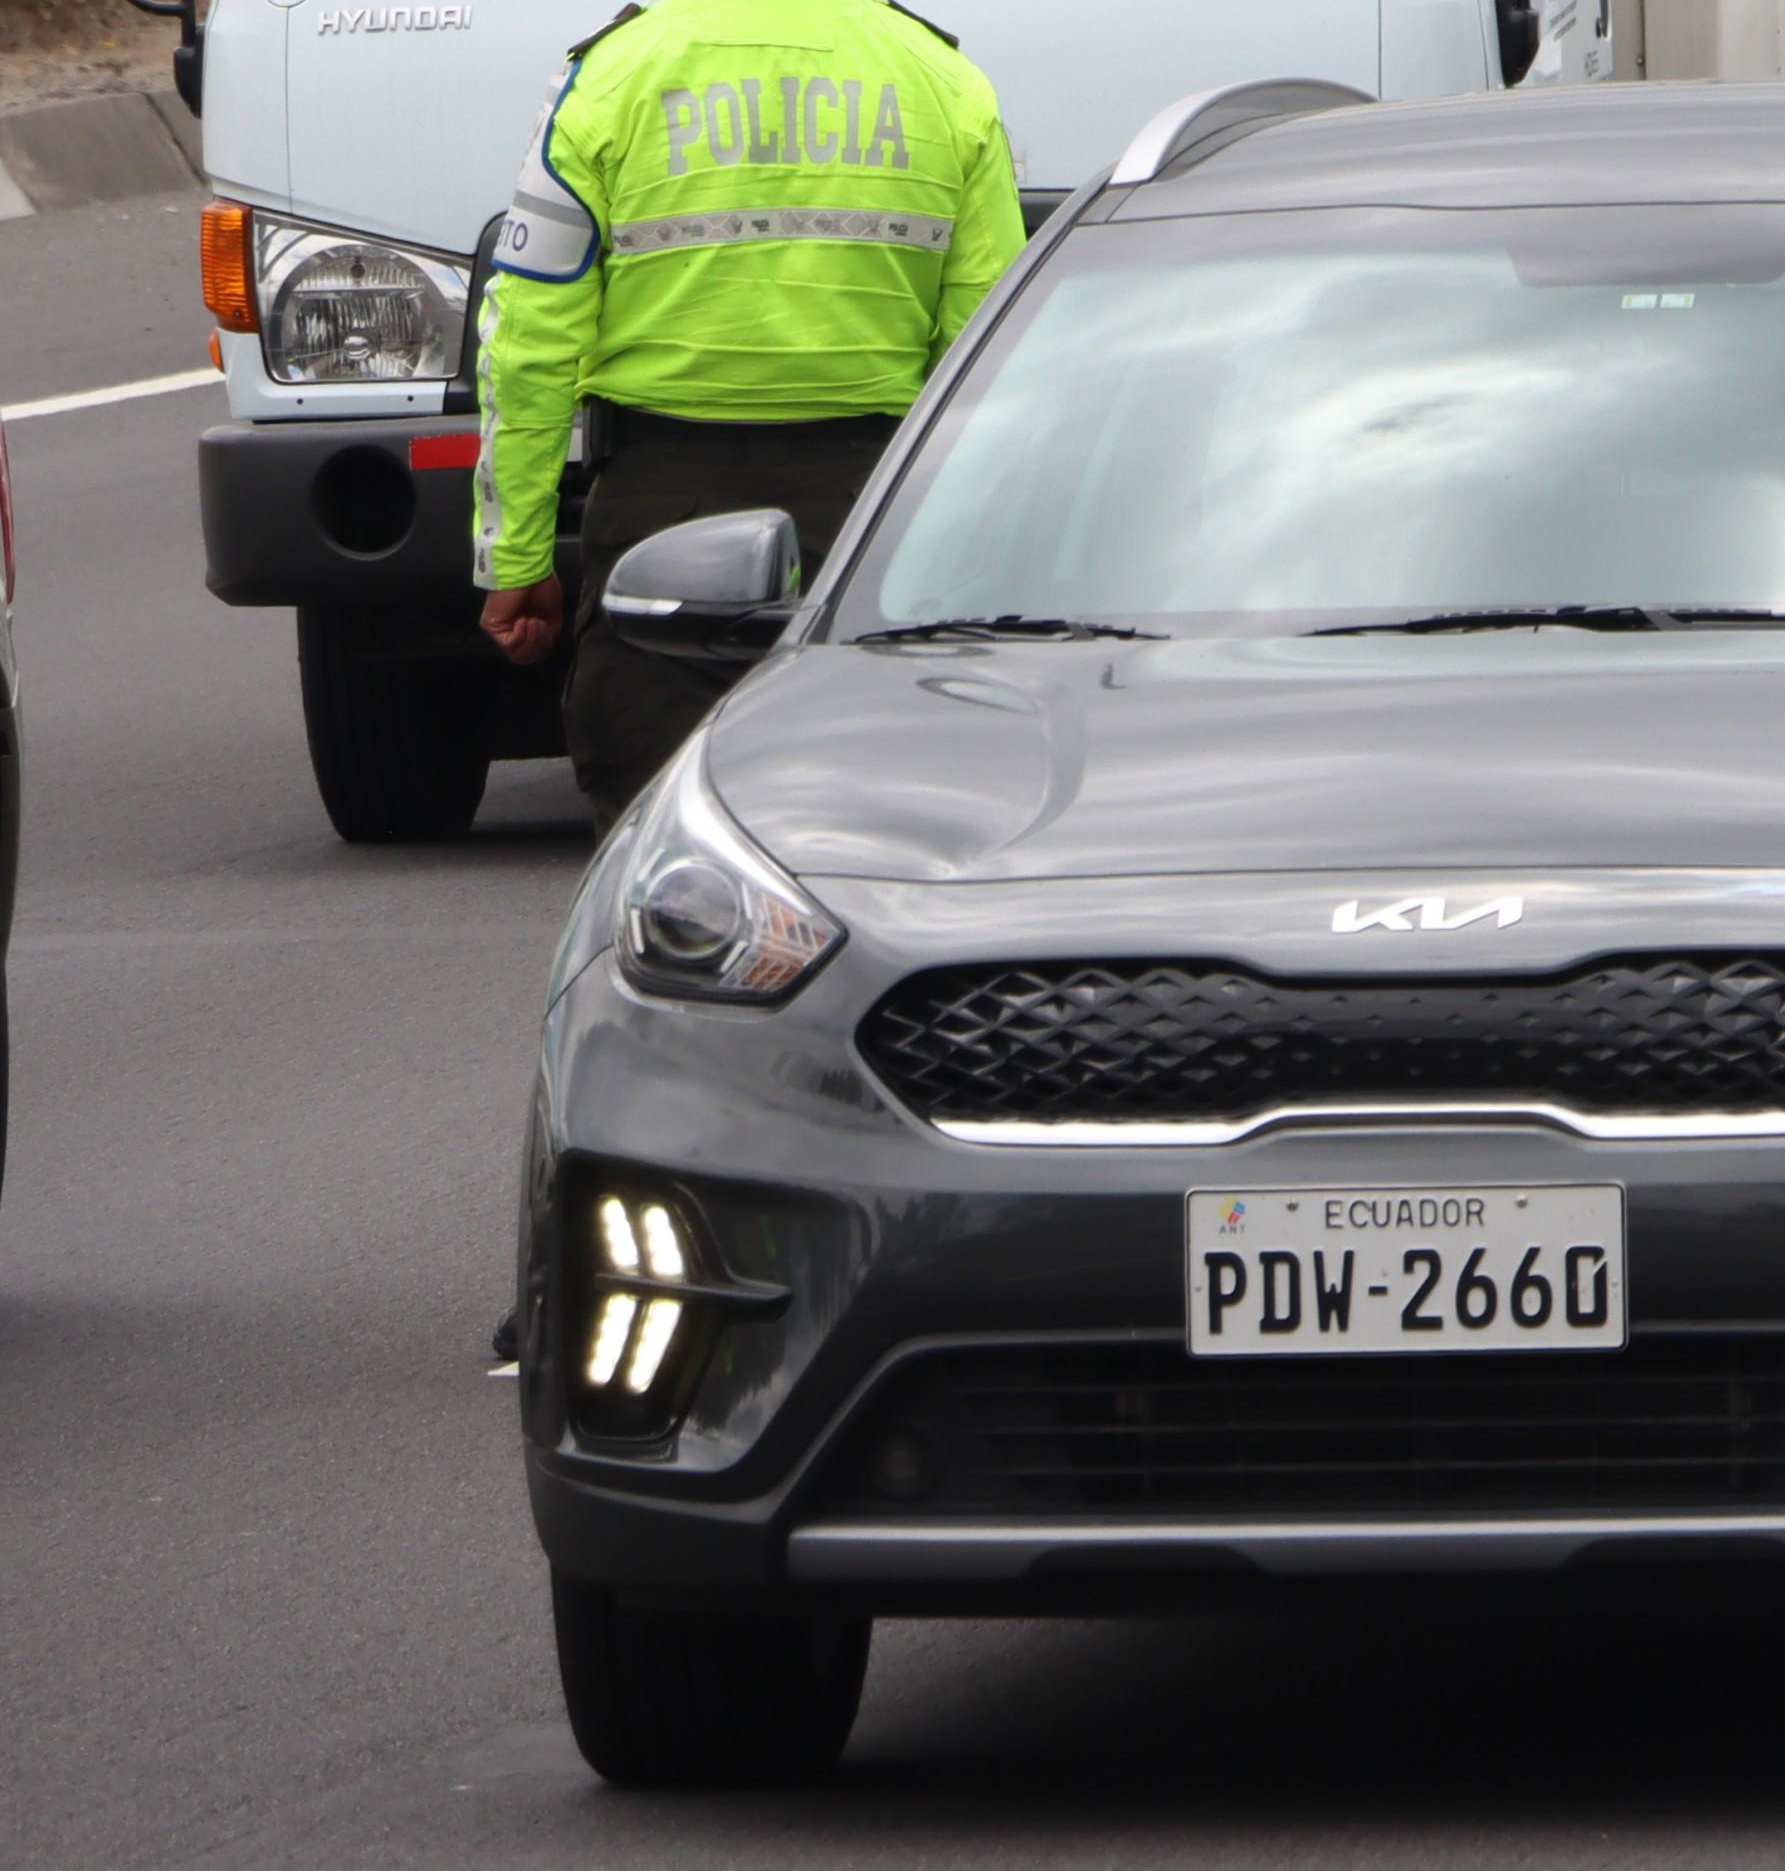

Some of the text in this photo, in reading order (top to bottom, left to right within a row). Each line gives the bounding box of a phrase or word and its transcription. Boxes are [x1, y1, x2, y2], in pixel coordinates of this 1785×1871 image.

[317, 3, 473, 36] HYUNDAI
[660, 75, 911, 175] POLICIA
[1324, 1198, 1486, 1229] ECUADOR
[1203, 1246, 1609, 1335] PDW-2660
